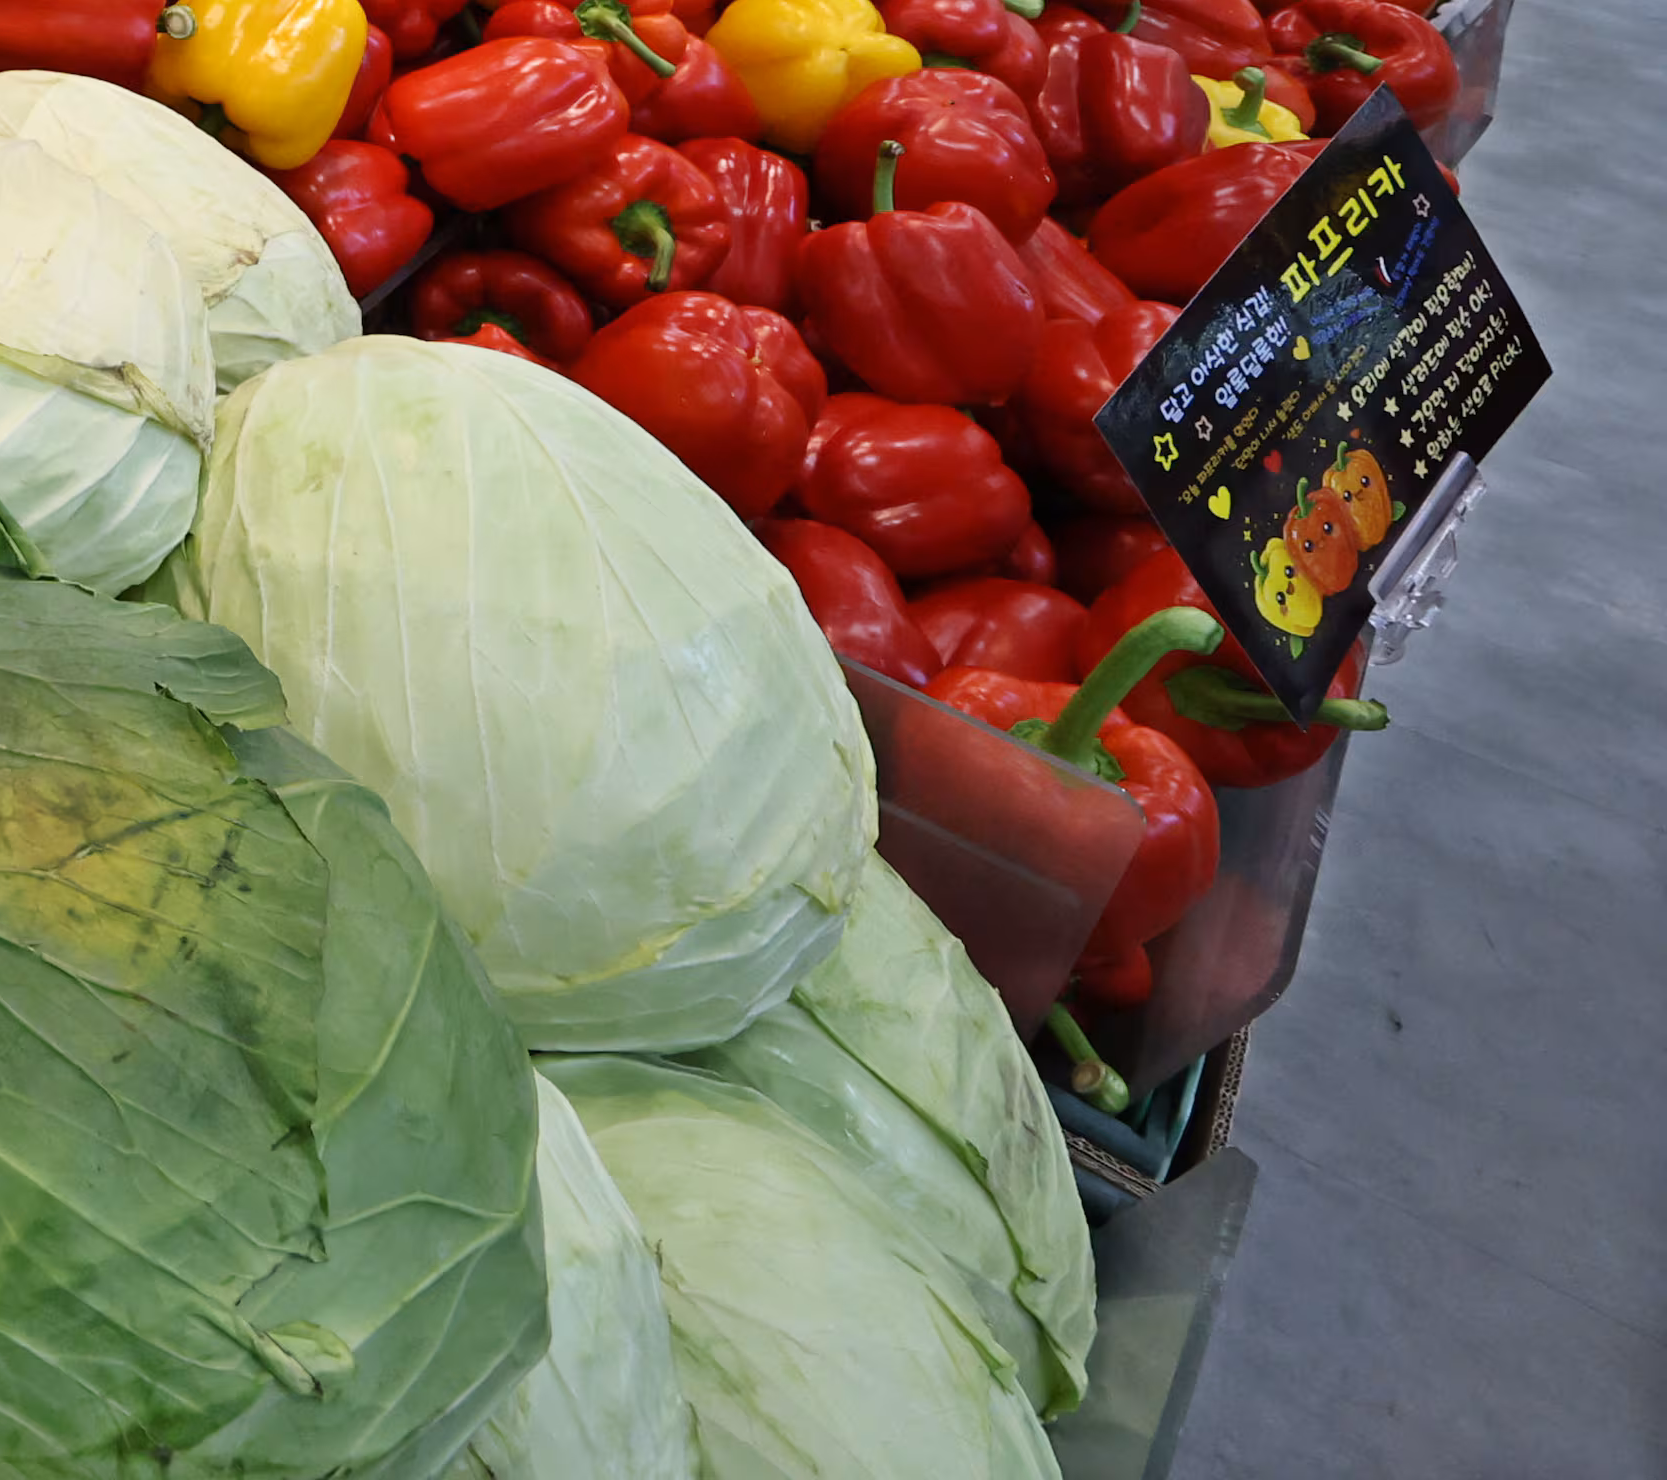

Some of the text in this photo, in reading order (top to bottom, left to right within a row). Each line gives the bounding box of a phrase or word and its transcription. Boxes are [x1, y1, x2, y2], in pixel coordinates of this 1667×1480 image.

[1281, 156, 1406, 304] 파프리카
[1161, 287, 1274, 424] 달고 아삭한 식감!
[1216, 316, 1292, 410] 알록달록한!
[1352, 359, 1391, 407] 요리에
[1390, 315, 1428, 359] 색감이
[1425, 253, 1473, 316] 필요할때!
[1403, 281, 1493, 396] 샐러드에 필수 OK!
[1412, 310, 1506, 433] 구우면 더 달아지는!
[1427, 338, 1520, 461] 원하는 색으로 Pick!
